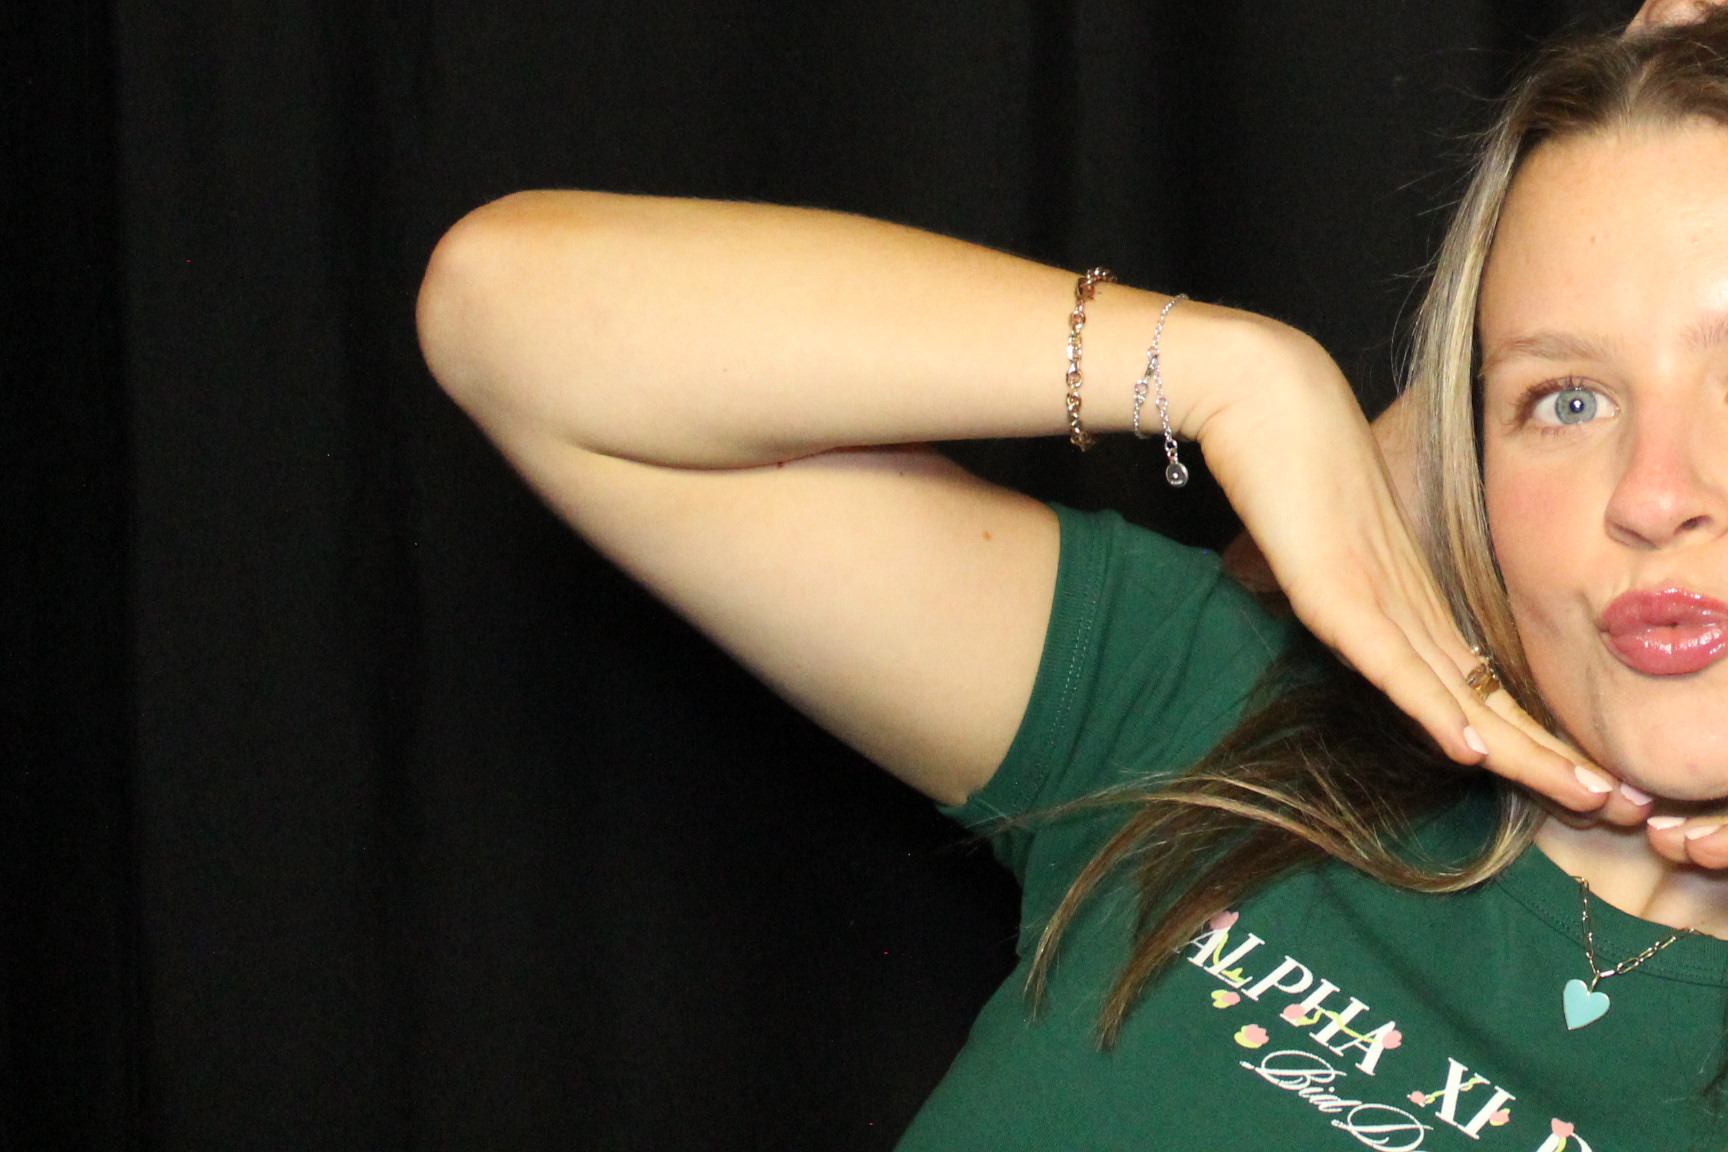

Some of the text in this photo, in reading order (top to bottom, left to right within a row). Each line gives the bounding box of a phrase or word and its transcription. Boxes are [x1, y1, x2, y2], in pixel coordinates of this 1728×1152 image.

[1186, 926, 1516, 1140] ALPHA XI
[1239, 1050, 1434, 1152] Bid D
